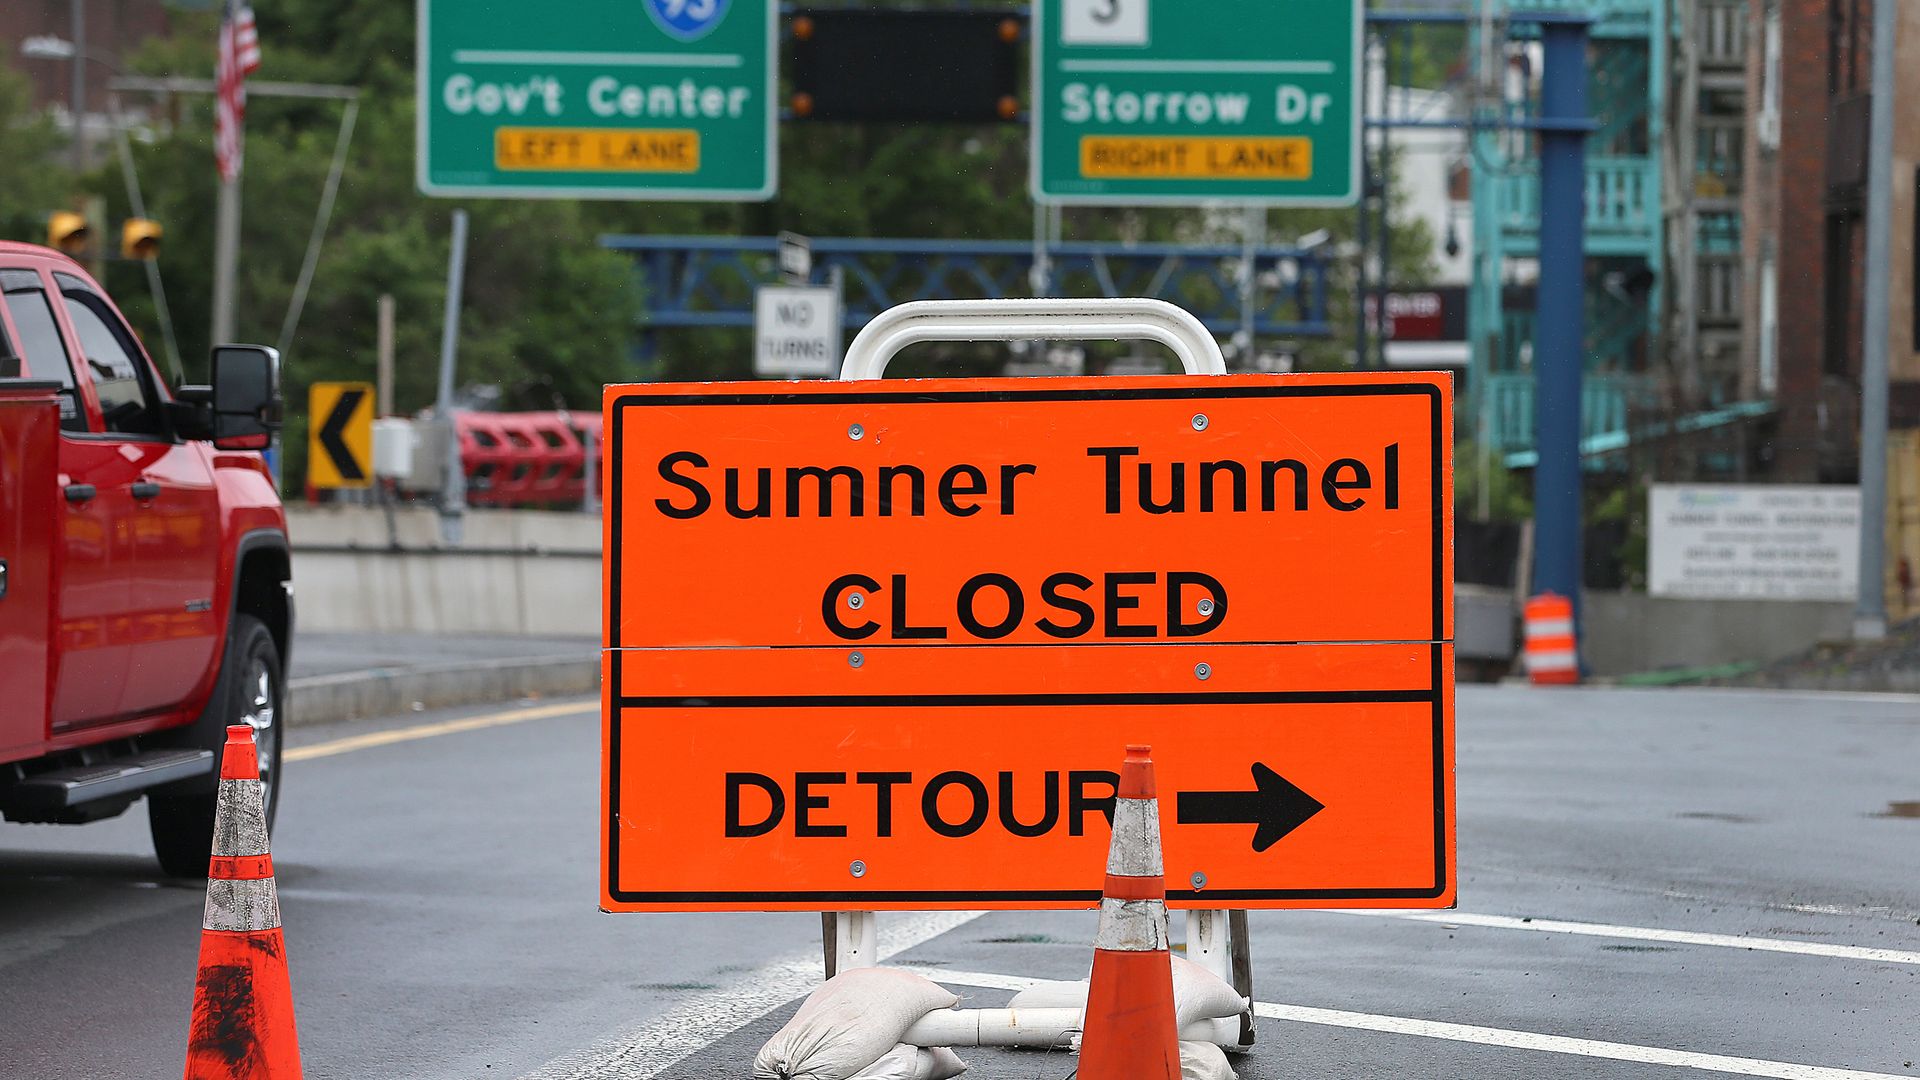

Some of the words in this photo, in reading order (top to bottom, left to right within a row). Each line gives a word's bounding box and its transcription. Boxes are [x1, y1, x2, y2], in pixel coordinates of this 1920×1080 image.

[443, 74, 563, 115] Gov't
[587, 76, 748, 118] Center
[1061, 83, 1250, 123] Storrow
[1276, 85, 1331, 124] Dr
[500, 133, 581, 161] LEFT
[602, 135, 690, 164] LANE
[1091, 143, 1188, 171] RIGHT
[1207, 145, 1298, 172] LANE
[775, 300, 815, 329] NO
[764, 336, 828, 361] TURNS
[654, 451, 1037, 519] Sumner
[1087, 442, 1399, 515] Tunnel
[821, 571, 1228, 641] CLOSED
[725, 770, 1121, 838] DETOUR
